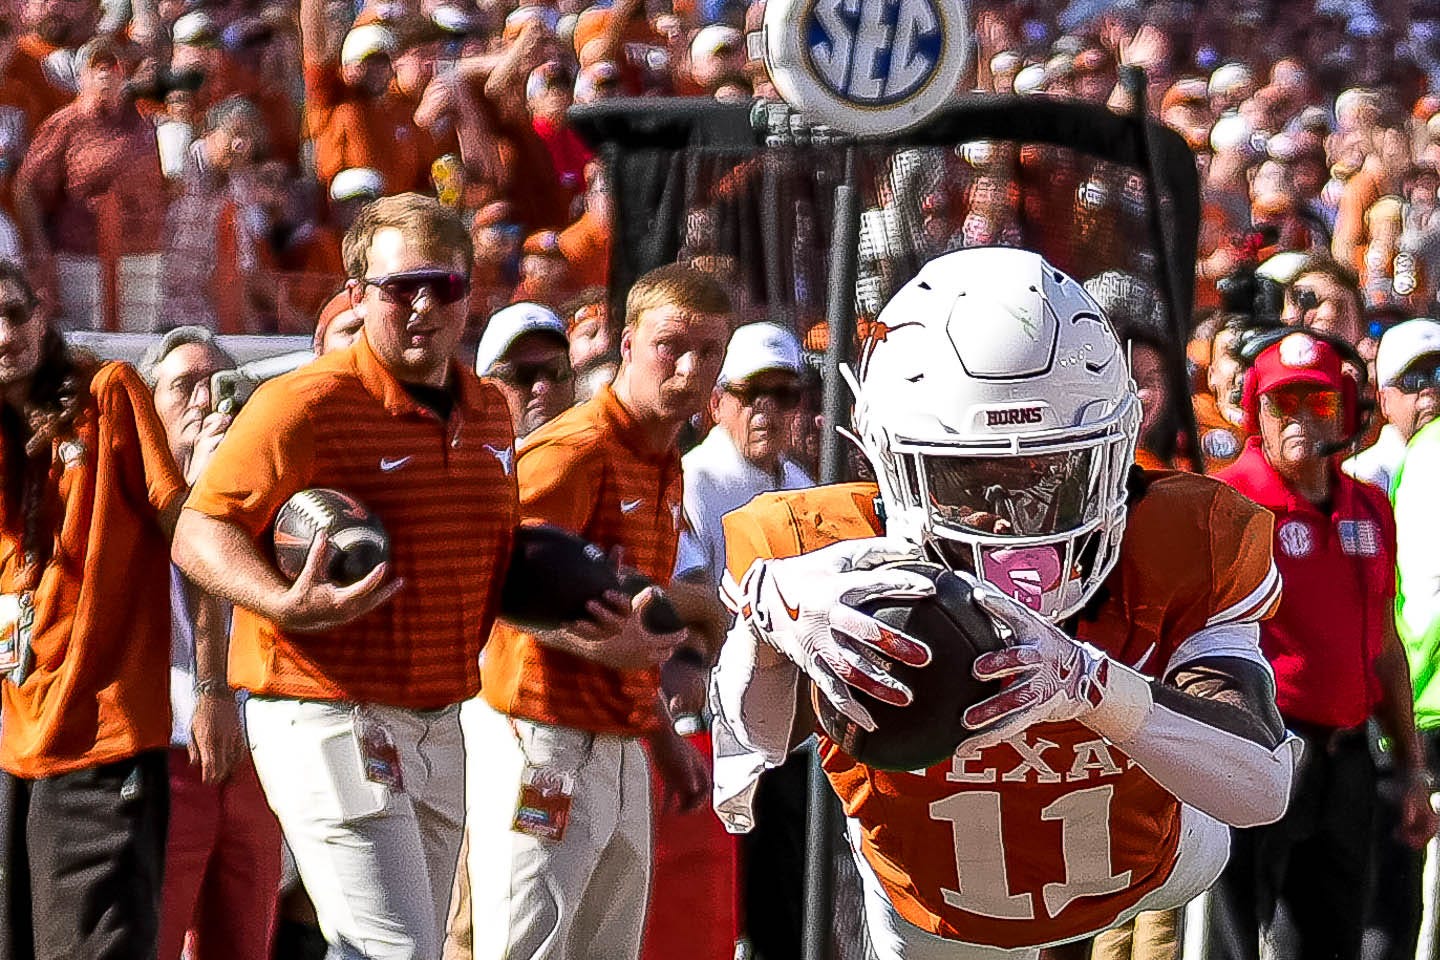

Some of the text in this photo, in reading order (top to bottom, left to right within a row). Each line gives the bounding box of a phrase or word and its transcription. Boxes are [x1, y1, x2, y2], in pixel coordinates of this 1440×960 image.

[812, 0, 938, 99] SEC
[985, 406, 1043, 427] HORNS
[929, 784, 1132, 919] 11
